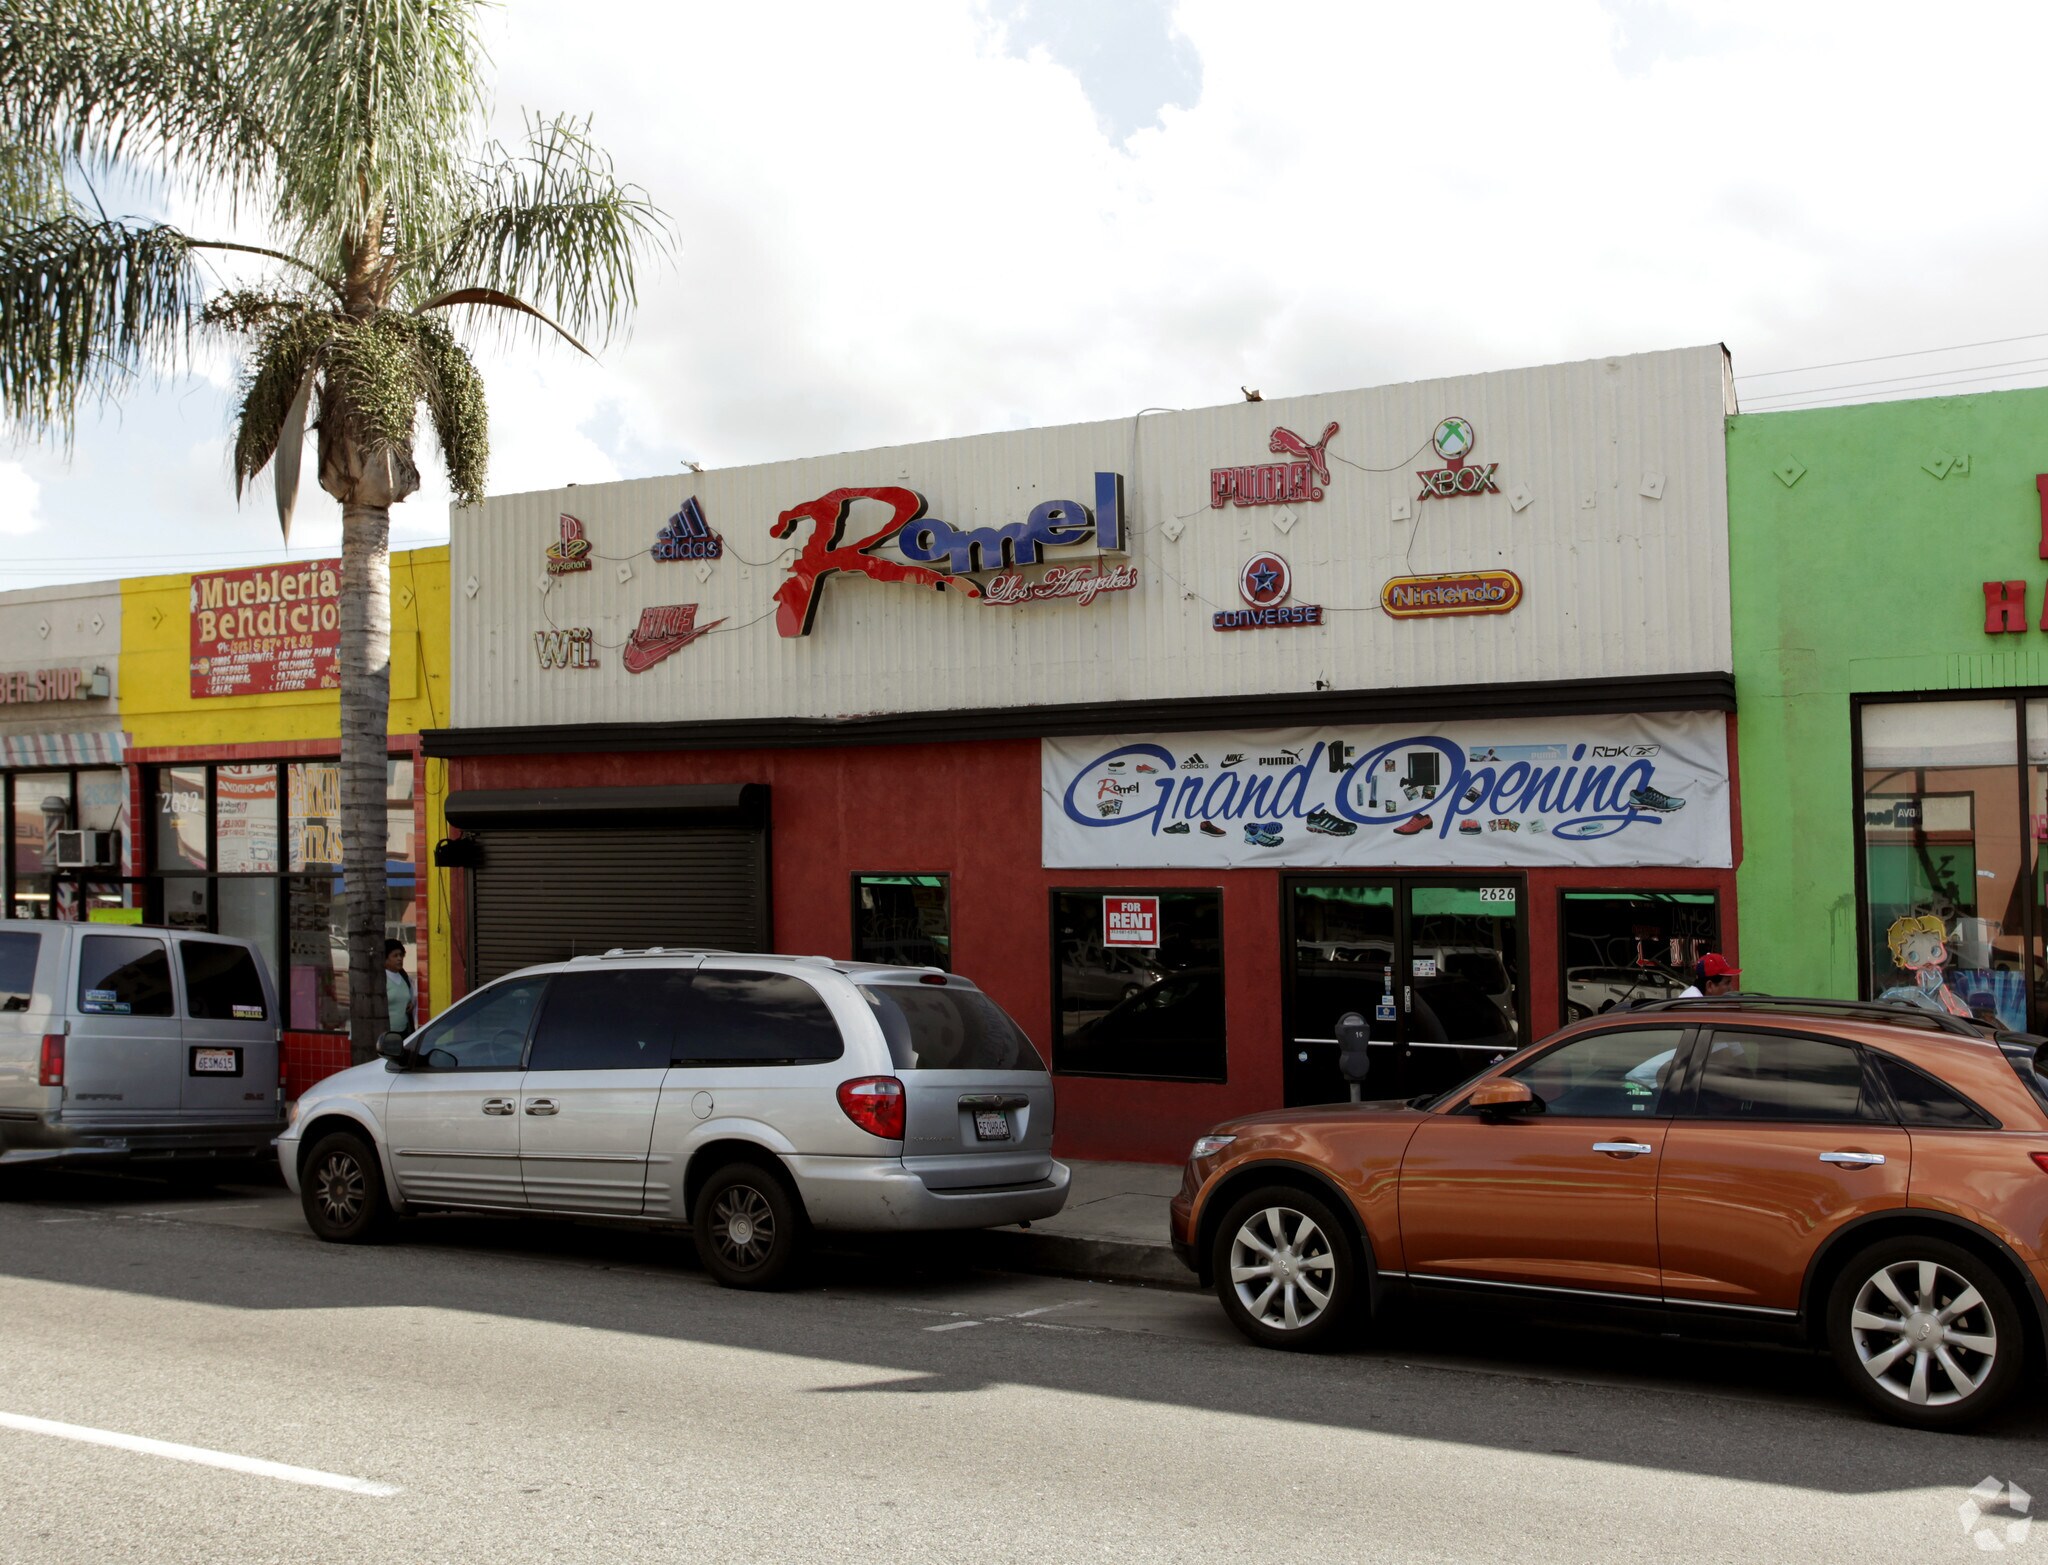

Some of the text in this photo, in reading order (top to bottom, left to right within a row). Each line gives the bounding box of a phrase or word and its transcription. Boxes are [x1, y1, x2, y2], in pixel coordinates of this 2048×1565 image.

[1211, 460, 1311, 508] PUMA
[1418, 463, 1499, 500] XBOX
[651, 537, 718, 561] adidas
[769, 471, 1125, 638] Romel
[200, 562, 340, 609] Muebleria
[984, 565, 1138, 605] Los Angeles
[1393, 584, 1506, 607] Nintendo
[1212, 606, 1319, 629] CONVERSE
[1983, 580, 2048, 634] H
[640, 604, 698, 641] NIKE
[313, 647, 332, 657] PLAN
[534, 628, 592, 668] Wii
[35, 666, 81, 702] SHOP
[275, 680, 305, 690] LITERAS
[1225, 753, 1245, 762] NIKE
[1259, 756, 1294, 766] PUMA
[287, 766, 342, 818] PARKIN
[1063, 736, 1662, 840] Grand Opening
[1097, 778, 1139, 800] Romel
[161, 791, 199, 813] 2632
[1481, 888, 1515, 901] 2626
[1121, 902, 1141, 912] FOR
[1109, 912, 1153, 929] RENT
[199, 1057, 234, 1069] 6ESM615
